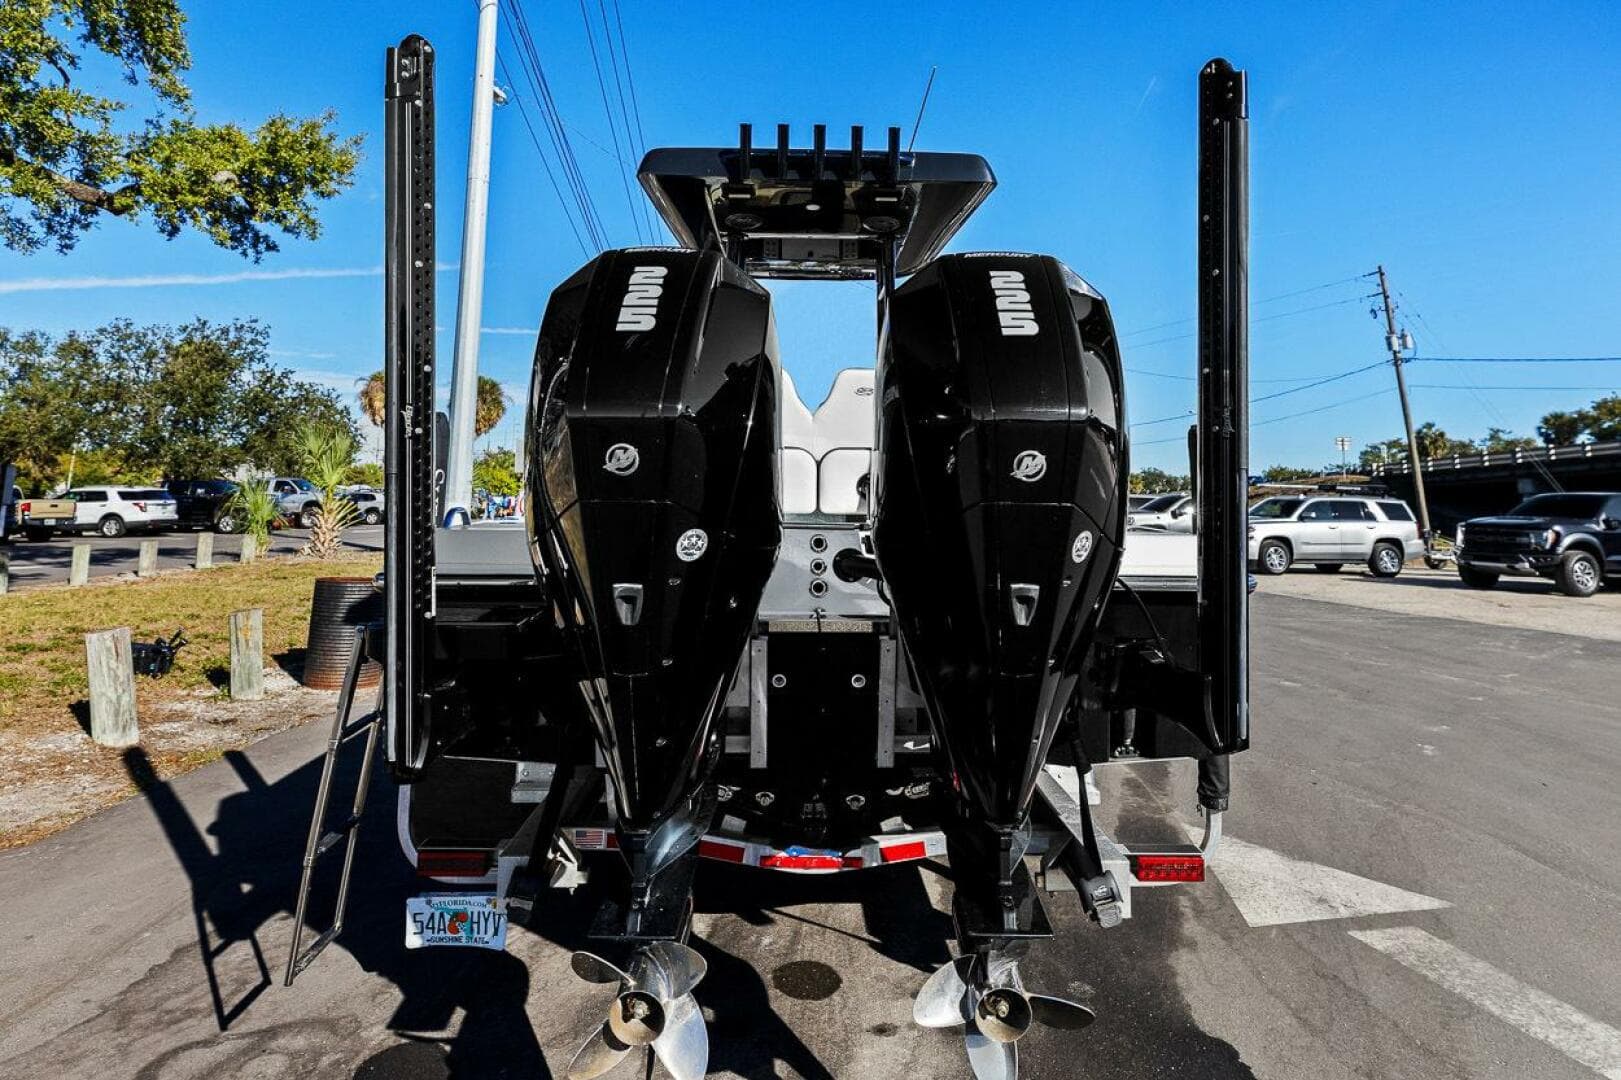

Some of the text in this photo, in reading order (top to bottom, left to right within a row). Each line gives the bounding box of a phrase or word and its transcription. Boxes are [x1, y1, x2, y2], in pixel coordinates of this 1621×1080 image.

[616, 266, 668, 331] 225
[989, 270, 1040, 336] 225
[413, 912, 447, 935] 54A
[430, 936, 463, 944] SUNSHINE
